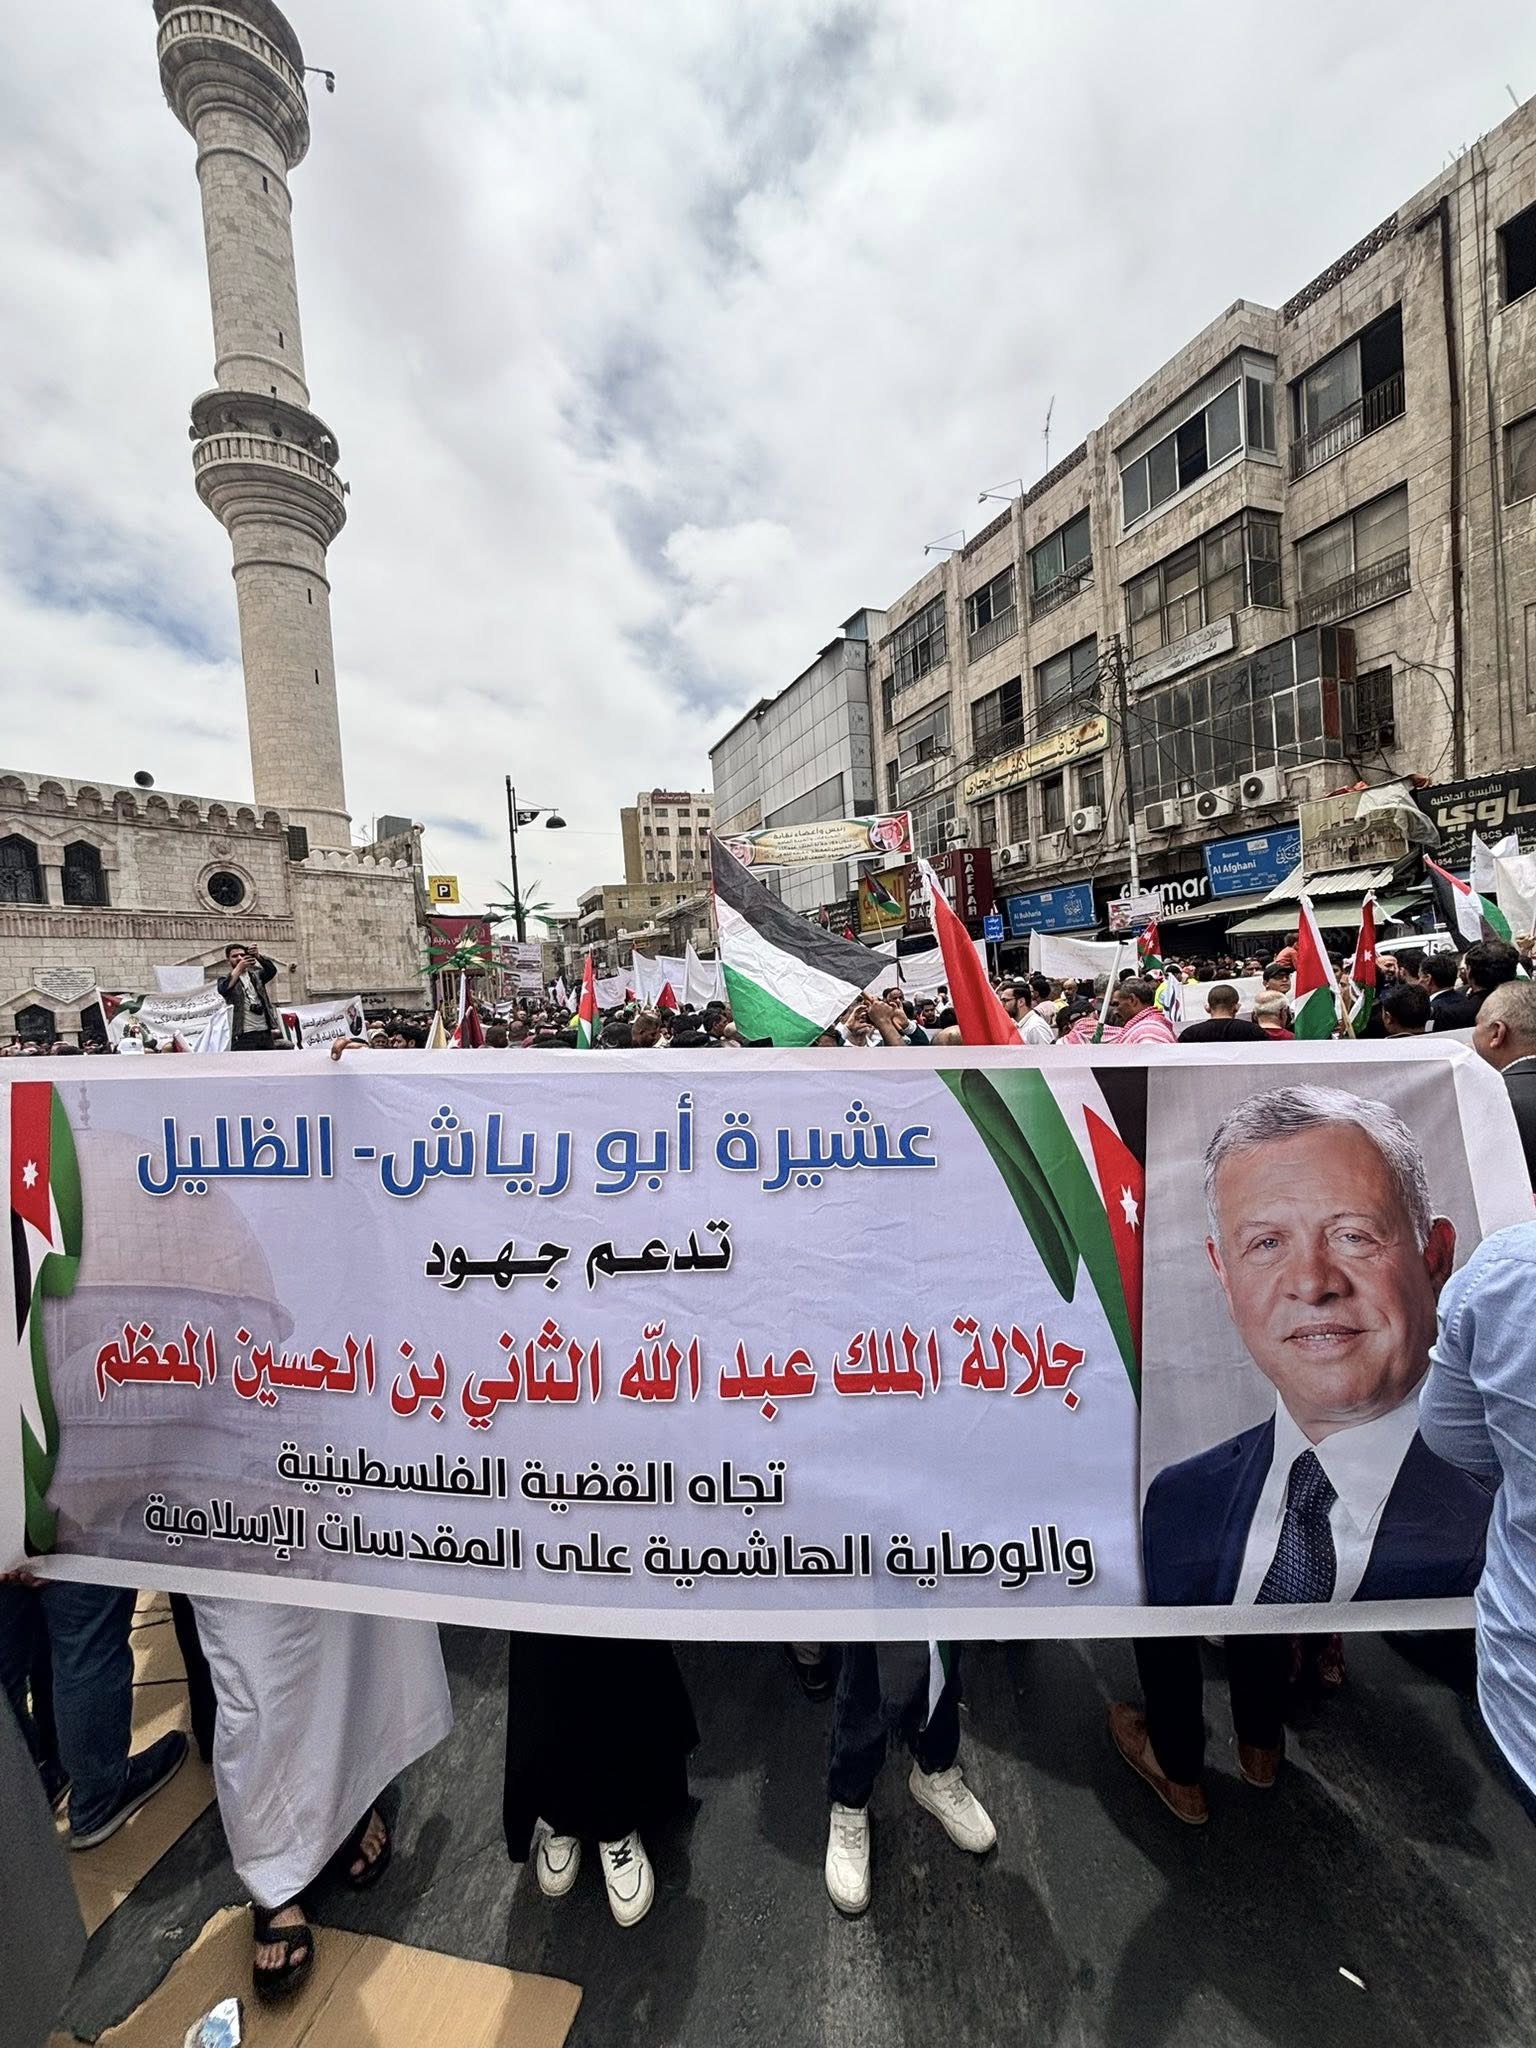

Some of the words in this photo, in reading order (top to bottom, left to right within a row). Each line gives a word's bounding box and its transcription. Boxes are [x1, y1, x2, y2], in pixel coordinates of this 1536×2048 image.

[1066, 727, 1105, 755] سوق
[440, 885, 449, 896] P
[963, 853, 977, 916] DAFFAH
[1213, 865, 1222, 875] Al
[1223, 859, 1256, 874] Afghani
[136, 1113, 333, 1196] الظليل
[594, 1091, 694, 1195] أبو
[714, 1099, 938, 1191] عشيرة
[424, 1239, 570, 1292] جهود
[585, 1218, 733, 1290] تدعم
[94, 1320, 218, 1403] المعظم
[231, 1326, 376, 1408] الحسين
[389, 1338, 448, 1423] بن
[460, 1316, 600, 1430] الثاني
[718, 1338, 818, 1422] عبد
[832, 1323, 940, 1399] الملك
[952, 1314, 1086, 1411] جلالة
[276, 1440, 508, 1499] الفلسطينية
[519, 1457, 675, 1514] القضية
[687, 1458, 788, 1518] تجاه
[143, 1493, 307, 1561] الإسلامية
[316, 1511, 523, 1570] المقدسات
[535, 1530, 633, 1576] على
[642, 1528, 872, 1589] الهاشمية
[883, 1524, 1097, 1589] والوصاية
